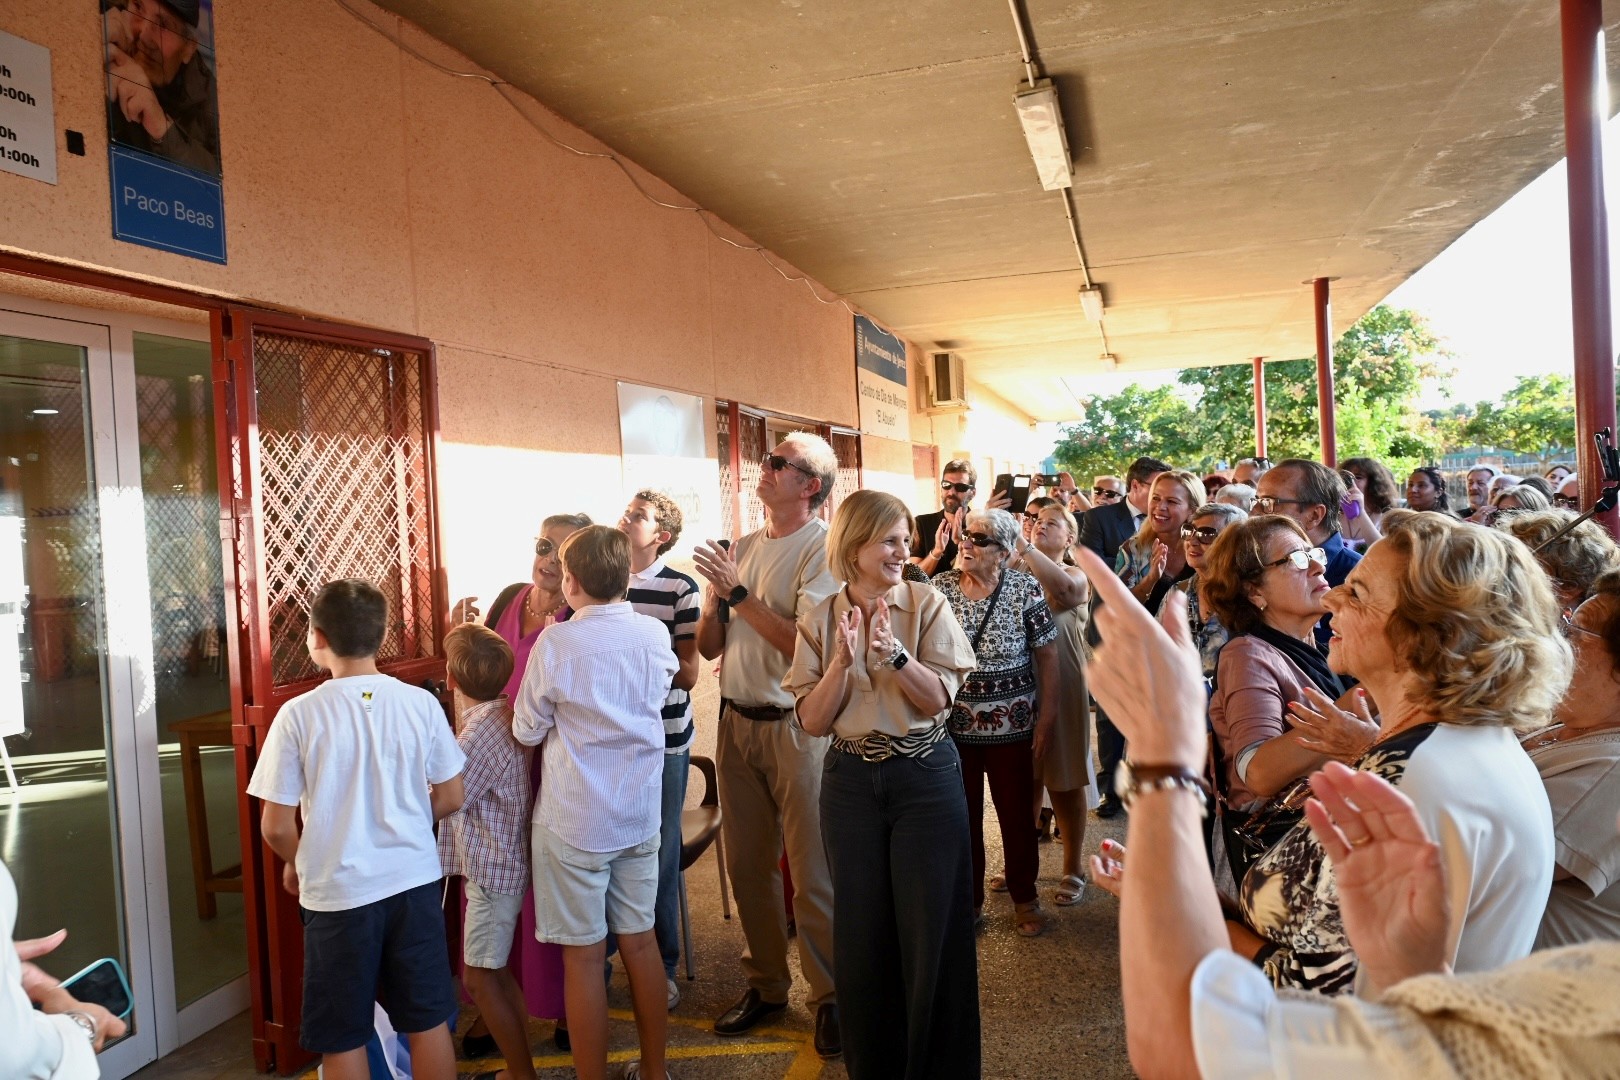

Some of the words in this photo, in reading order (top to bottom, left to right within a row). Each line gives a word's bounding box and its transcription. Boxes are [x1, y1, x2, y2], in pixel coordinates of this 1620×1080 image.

[0, 64, 11, 79] h
[124, 186, 169, 216] Paco
[174, 200, 215, 229] Beas
[865, 336, 892, 361] Ayuntamiento
[860, 380, 875, 399] Centro
[875, 388, 881, 401] de
[887, 392, 893, 406] de
[893, 393, 907, 410] Mayores
